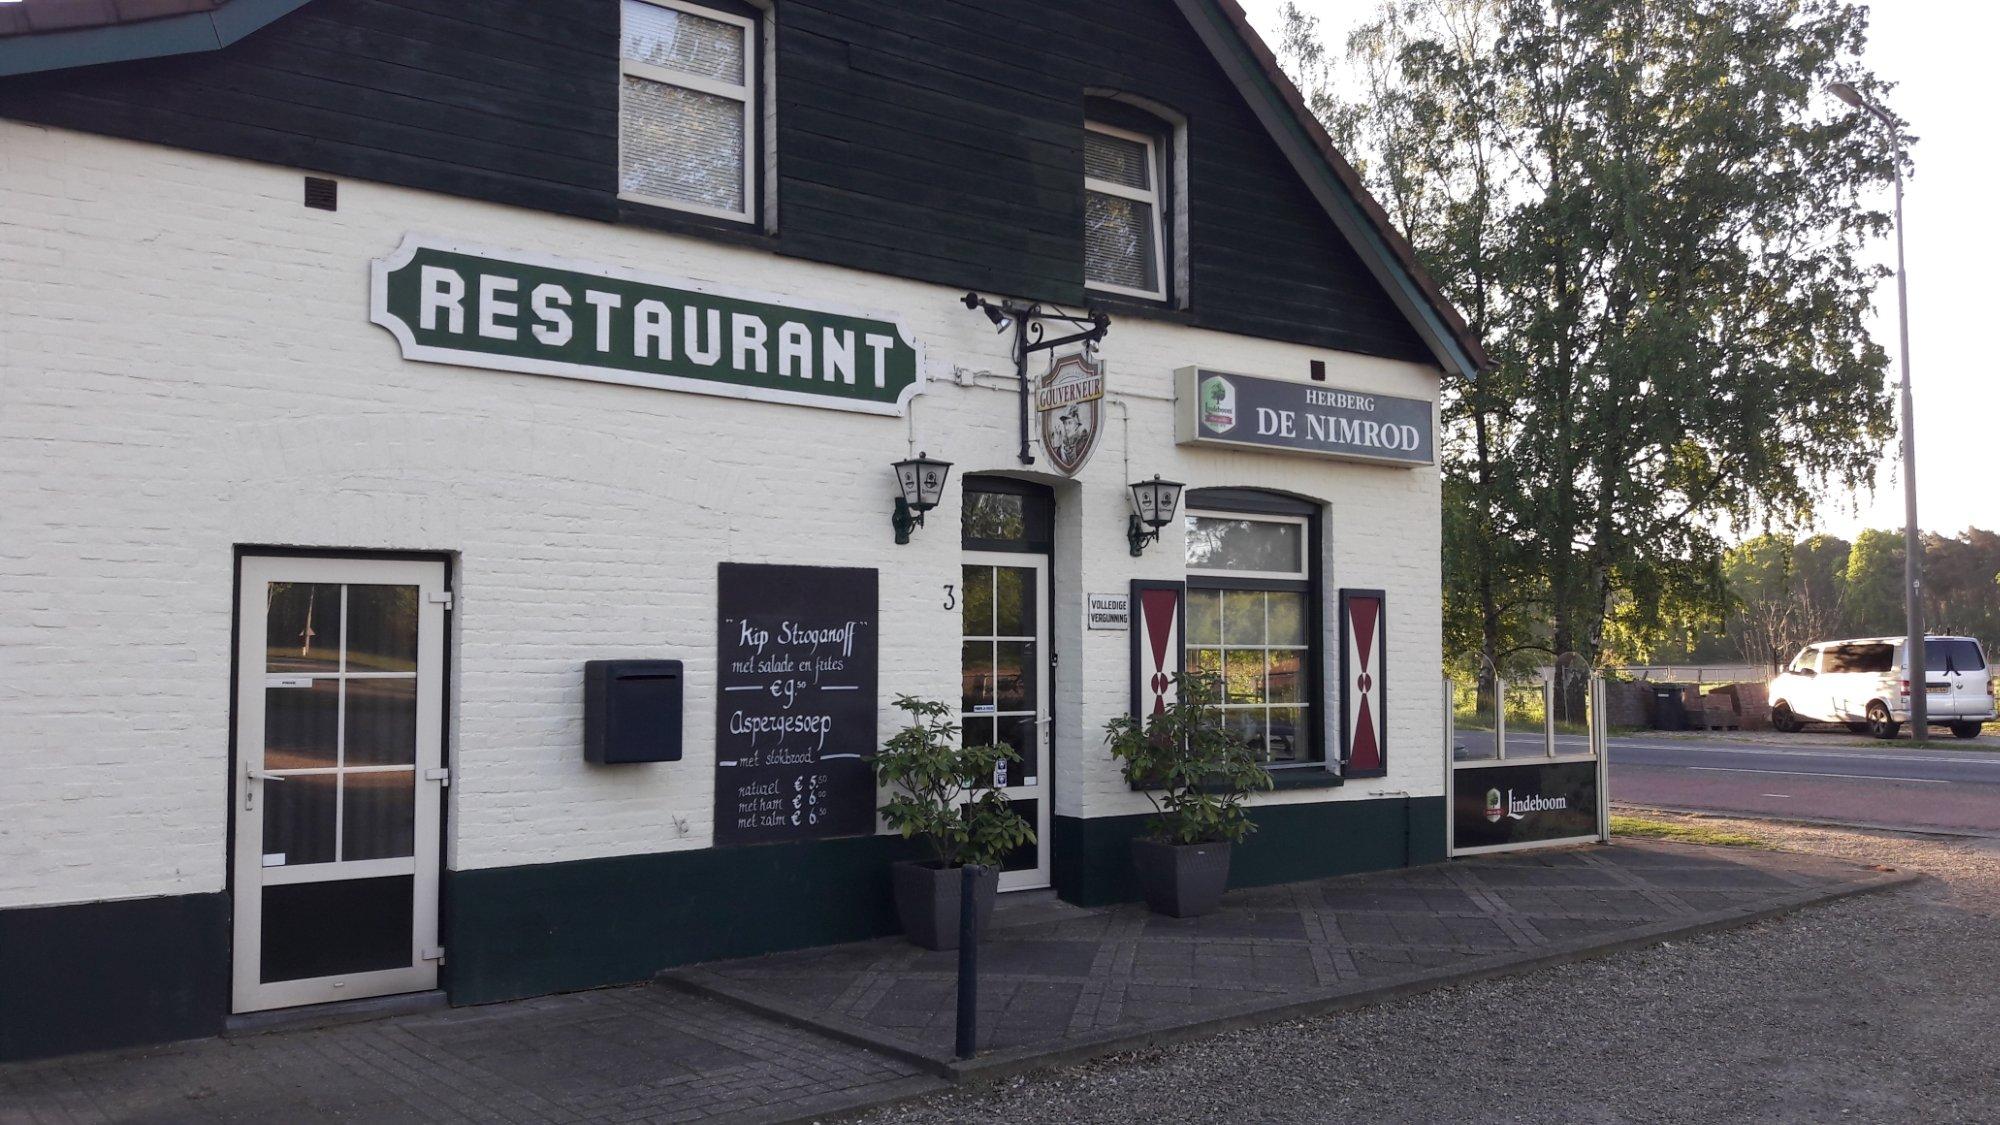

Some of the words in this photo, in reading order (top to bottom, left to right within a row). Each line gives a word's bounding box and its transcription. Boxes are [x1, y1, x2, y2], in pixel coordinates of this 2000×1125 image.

[419, 264, 895, 388] RESTAURANT
[1040, 378, 1100, 408] GOUVERNEUR
[1305, 389, 1375, 412] HERBERG
[1256, 407, 1297, 438] DE
[1305, 413, 1420, 451] NIMROD
[943, 584, 955, 610] 3
[1091, 600, 1127, 610] VOLLEDIGE
[1091, 613, 1128, 623] VERGUNNING
[732, 656, 755, 673] met
[758, 653, 794, 673] salade
[799, 661, 812, 672] en
[730, 710, 832, 752] Aspergesoep
[740, 749, 760, 767] met
[765, 746, 815, 765] stokbrood
[738, 779, 780, 798] naturel
[738, 797, 757, 813] met
[759, 798, 783, 812] ham
[1507, 788, 1567, 820] Lindeboom
[738, 814, 758, 830] met
[760, 811, 786, 827] zalm
